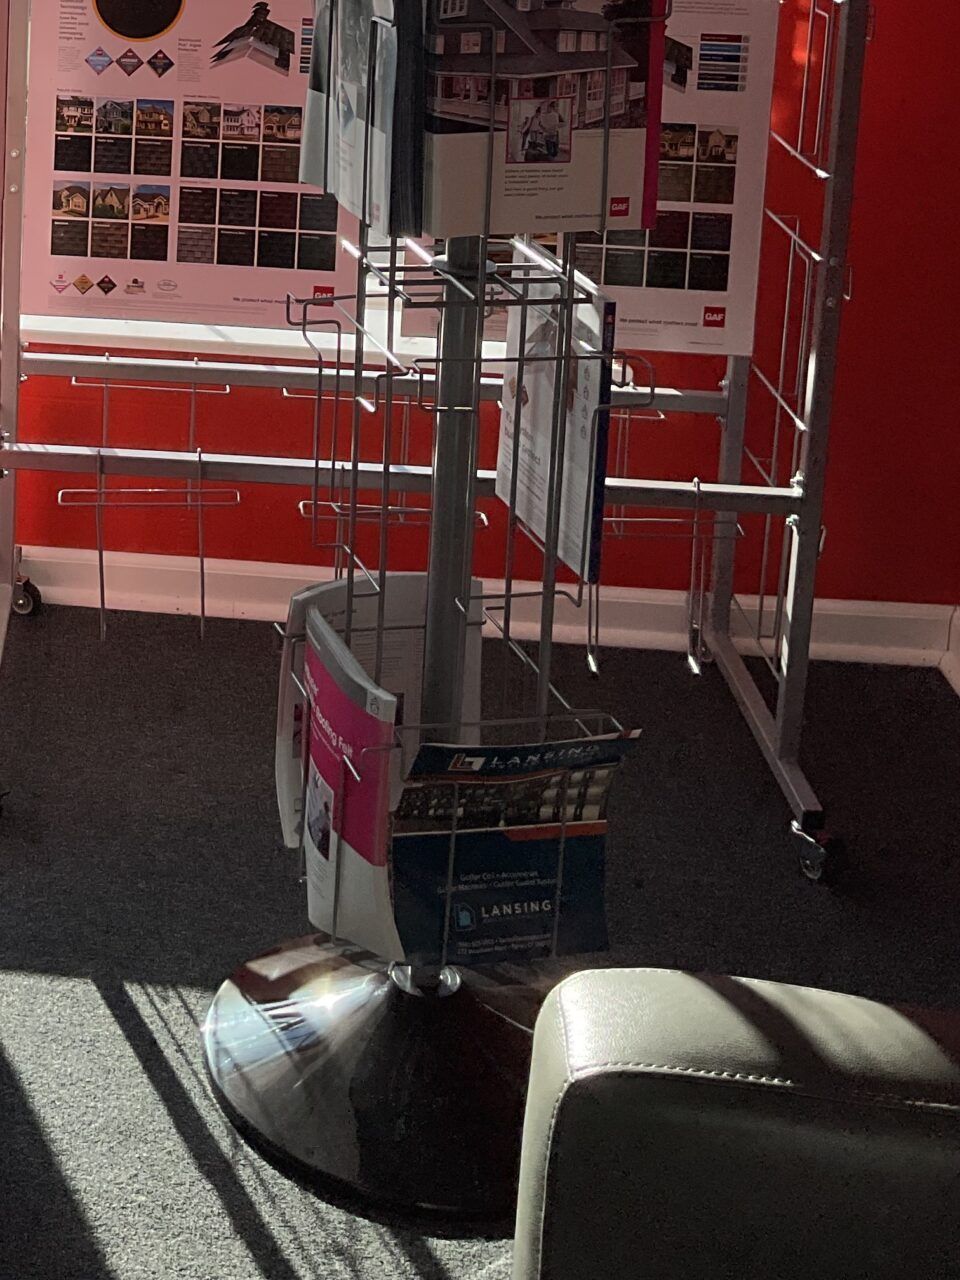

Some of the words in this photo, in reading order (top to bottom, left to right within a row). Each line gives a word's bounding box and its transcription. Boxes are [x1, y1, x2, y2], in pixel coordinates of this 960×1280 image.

[612, 203, 628, 211] GAF
[705, 312, 724, 321] GAF
[481, 899, 552, 918] LANSING
